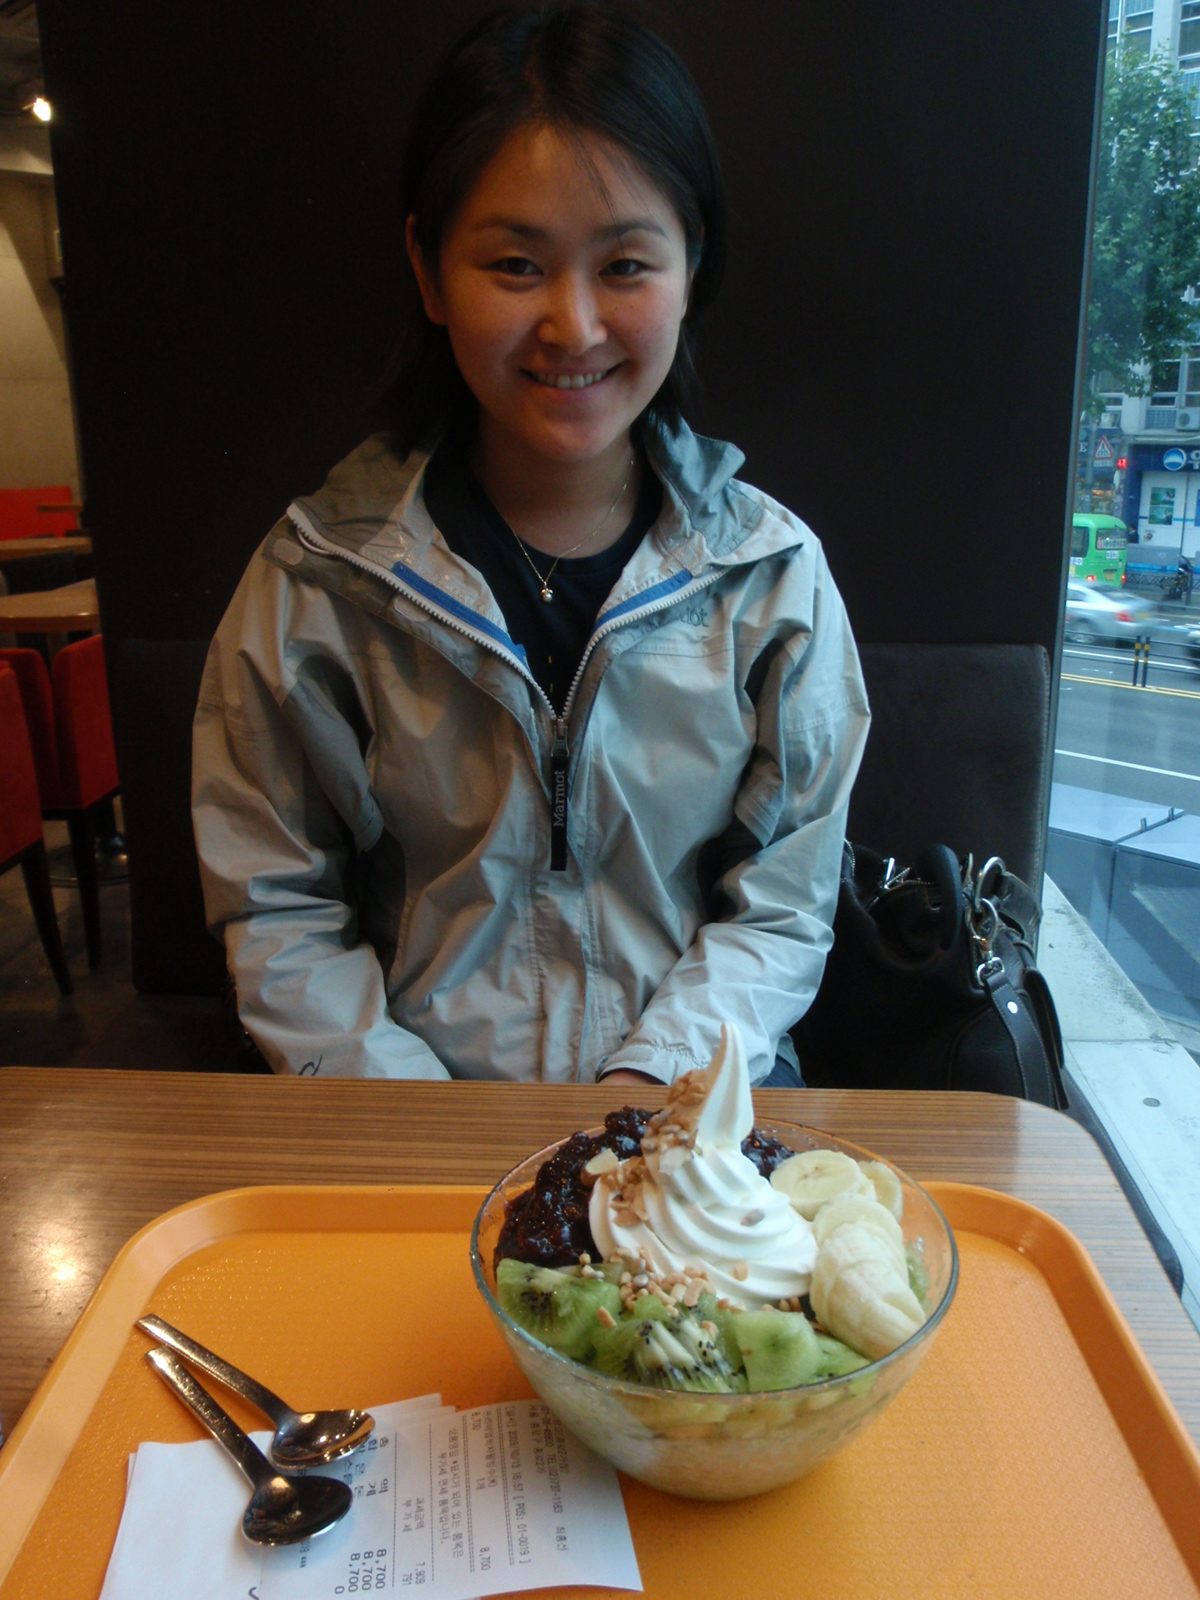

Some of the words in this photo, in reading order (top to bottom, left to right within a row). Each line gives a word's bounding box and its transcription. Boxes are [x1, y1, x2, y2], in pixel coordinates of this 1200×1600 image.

[553, 769, 566, 828] Marmot
[437, 1452, 449, 1475] 부가세
[438, 1479, 450, 1495] 면세
[414, 1497, 424, 1530] 과세금액
[450, 1511, 462, 1529] 있는
[515, 1503, 527, 1520] POS:
[452, 1532, 464, 1559] 품목은
[517, 1524, 530, 1556] 01-0019
[479, 1547, 490, 1570] 8,700
[402, 1572, 412, 1586] 791
[414, 1562, 425, 1585] 7,909
[334, 1585, 345, 1595] 0
